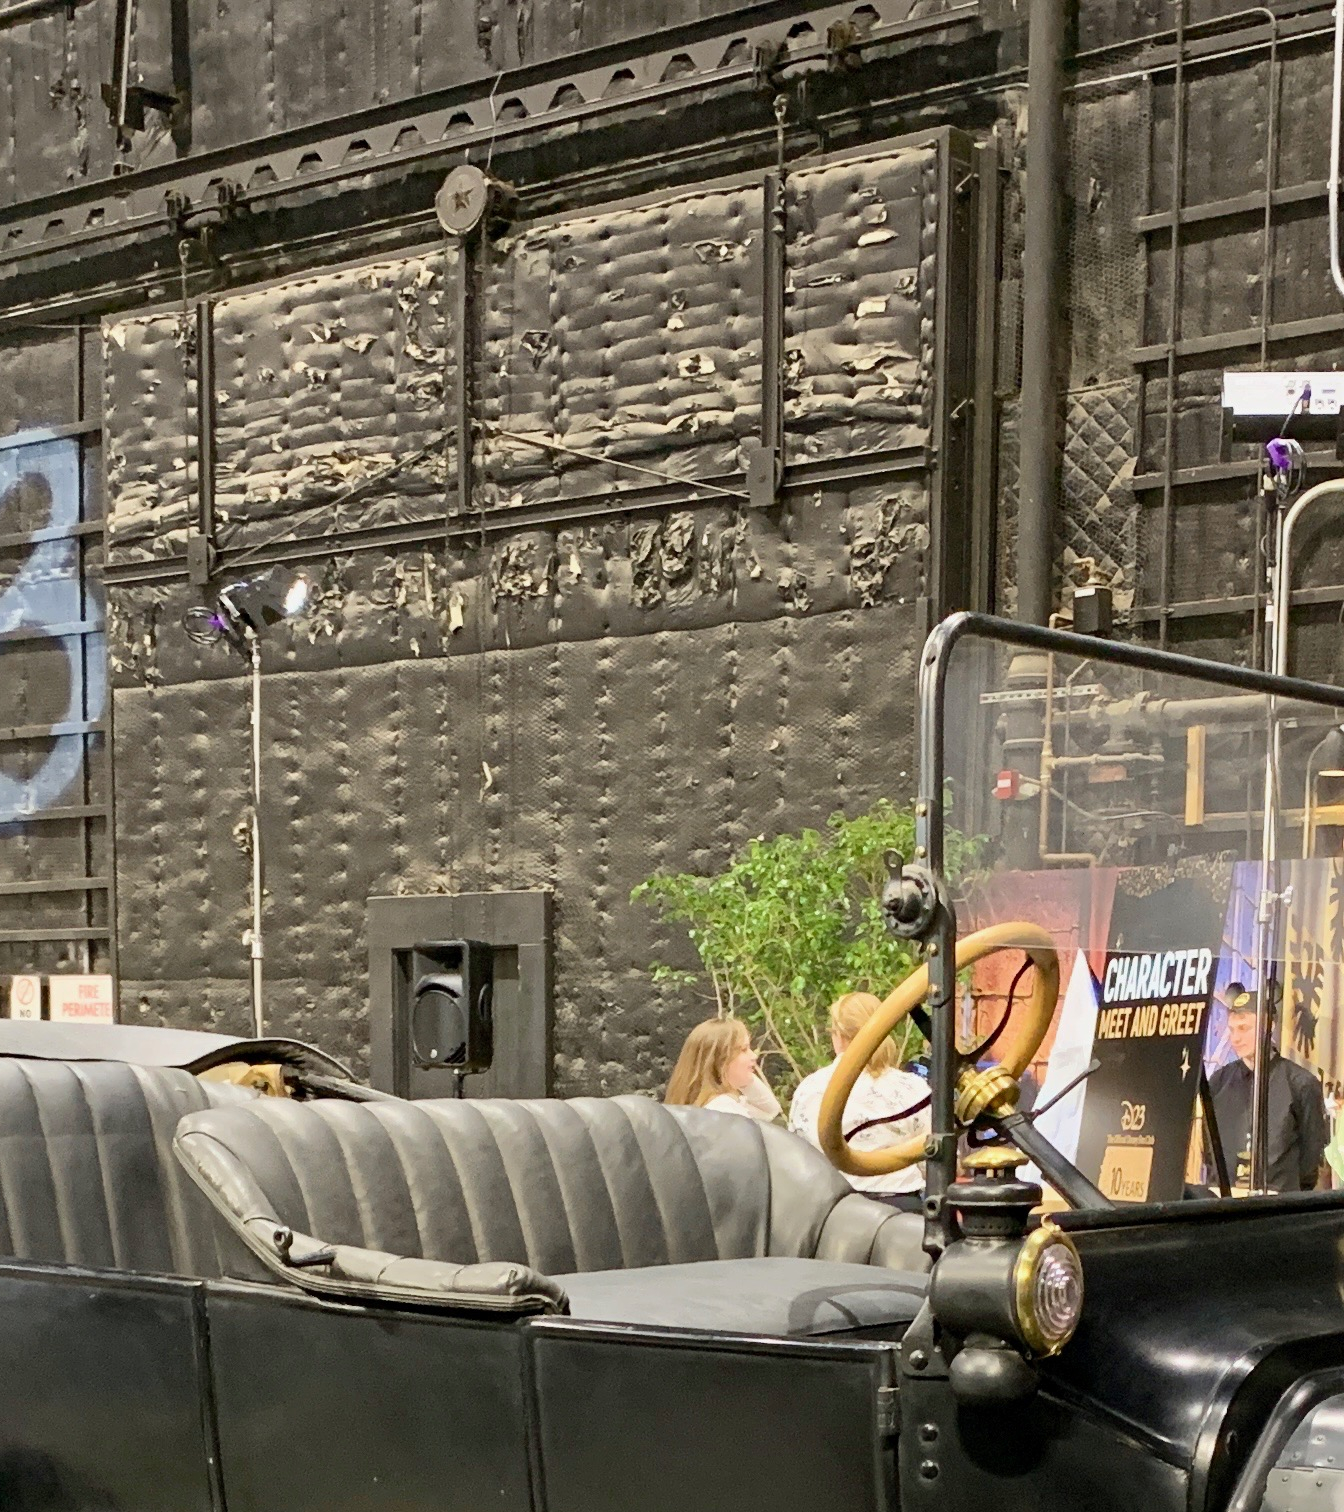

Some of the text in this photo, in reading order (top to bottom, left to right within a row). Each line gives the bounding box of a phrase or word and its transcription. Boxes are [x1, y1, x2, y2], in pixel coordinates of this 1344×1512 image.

[1103, 948, 1213, 1003] CHARACTER
[78, 984, 99, 998] FIRE
[19, 1008, 32, 1018] NO
[62, 1002, 111, 1017] PERIMETE
[1098, 1002, 1206, 1039] MEET AND GREET
[1120, 1100, 1146, 1131] D23
[1109, 1168, 1145, 1198] 10 YEARS
